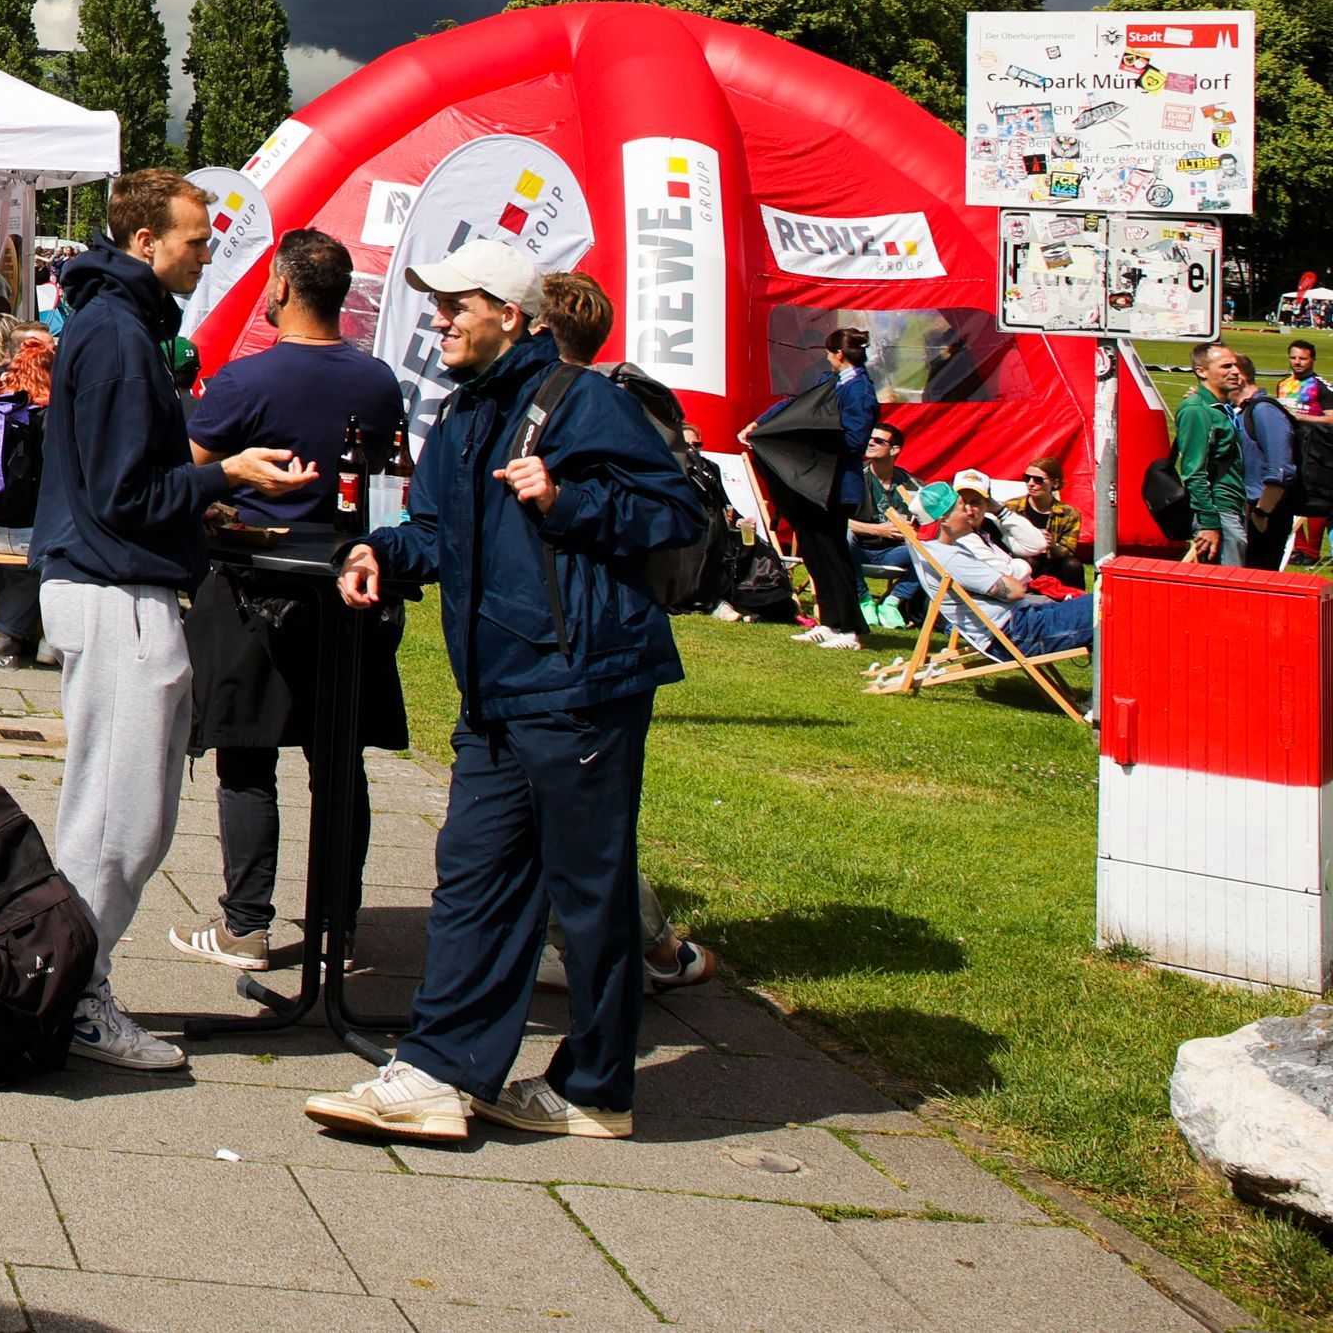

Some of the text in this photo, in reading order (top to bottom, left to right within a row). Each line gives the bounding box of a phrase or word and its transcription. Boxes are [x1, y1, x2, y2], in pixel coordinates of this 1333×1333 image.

[985, 32, 1076, 43] Der Oberbürgermeister
[1129, 31, 1163, 42] Stadt
[1135, 140, 1206, 151] städtischen
[252, 138, 288, 180] ROUP
[1177, 157, 1220, 170] ULTRAS
[1052, 174, 1079, 185] FCK
[697, 160, 713, 222] GROUP
[1052, 185, 1078, 194] NZS
[526, 185, 564, 254] ROUP
[223, 203, 257, 259] GROUP
[773, 216, 881, 257] REWE
[876, 260, 924, 272] GROUP
[637, 205, 694, 366] REWE
